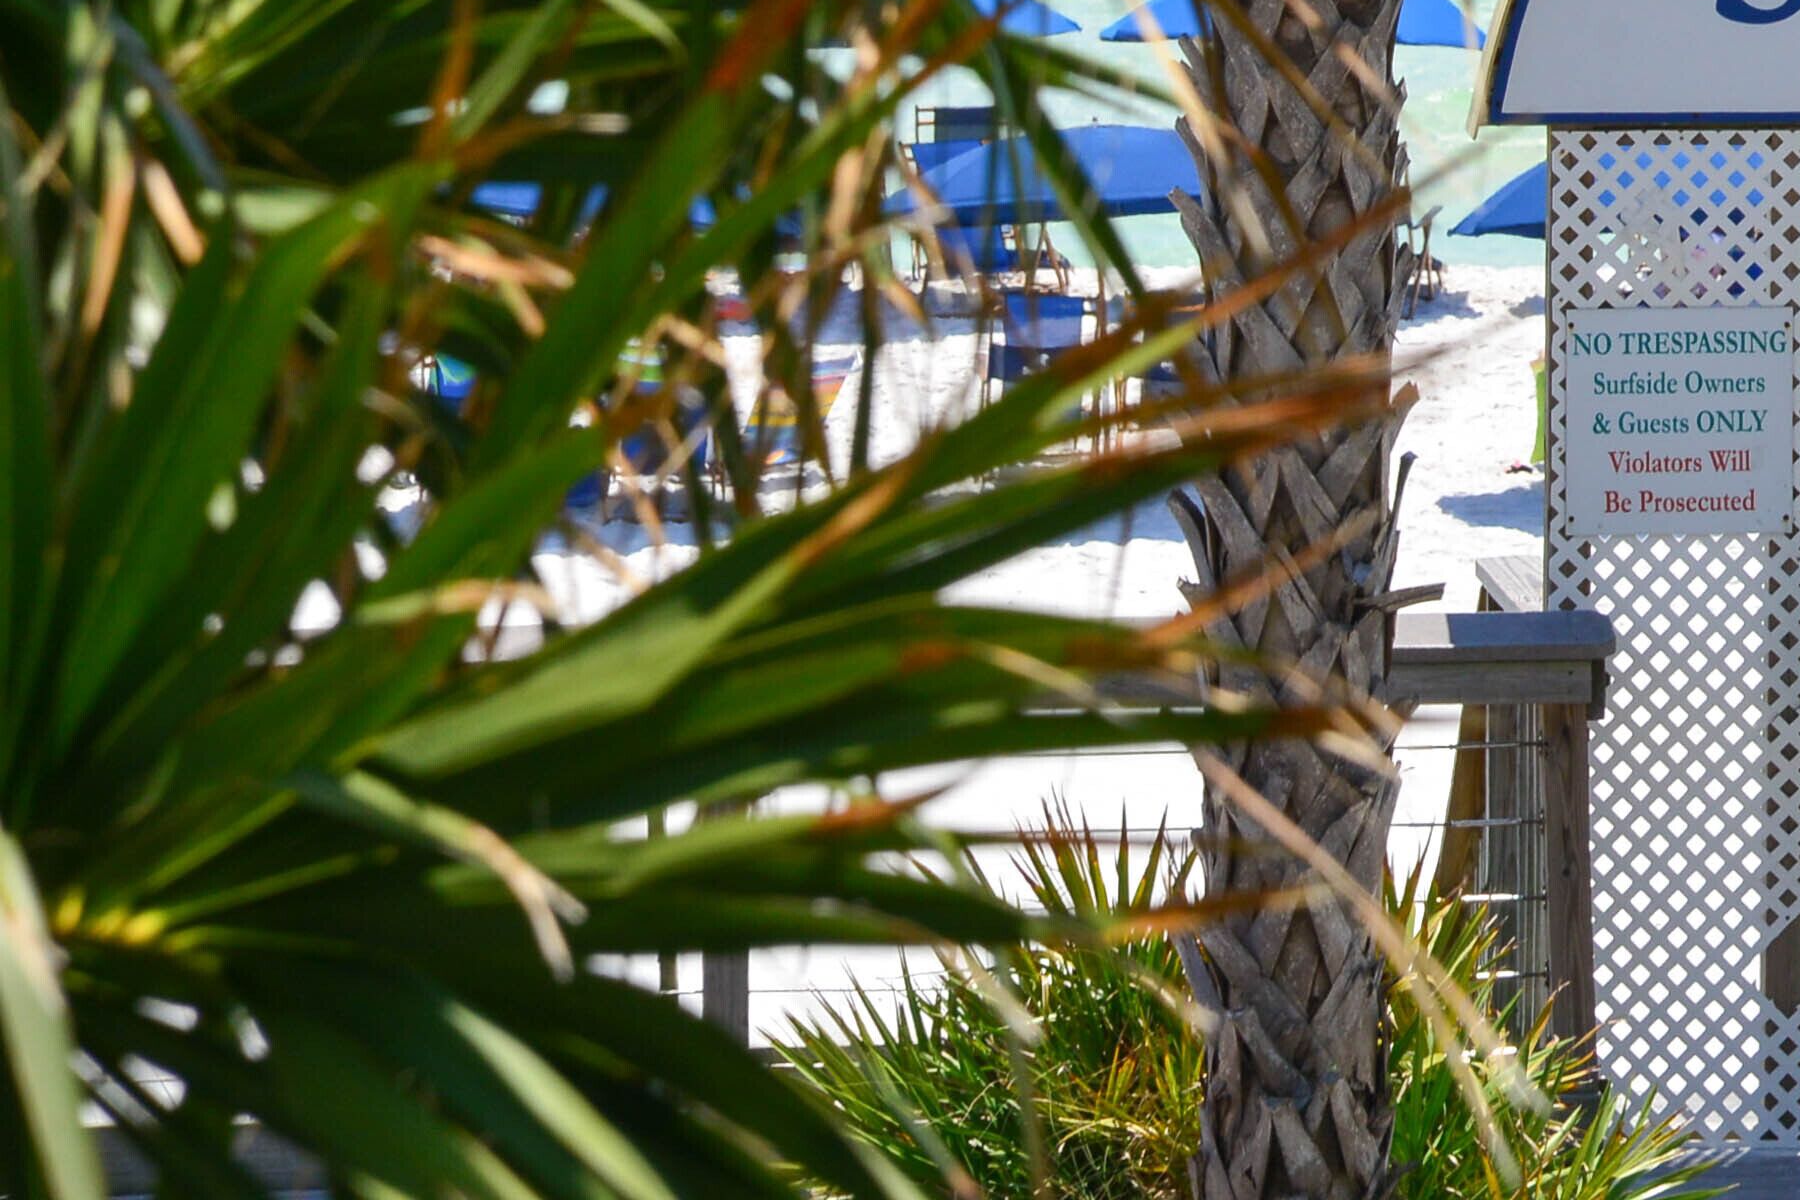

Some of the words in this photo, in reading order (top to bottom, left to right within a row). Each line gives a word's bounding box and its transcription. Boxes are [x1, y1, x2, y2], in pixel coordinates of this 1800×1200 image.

[1573, 332, 1611, 355] NO
[1619, 331, 1787, 354] TRESPASSING
[1593, 371, 1677, 395] Surfside
[1685, 370, 1766, 393] Owners
[1592, 412, 1611, 434] &
[1618, 411, 1690, 434] Guests
[1696, 409, 1767, 432] ONLY
[1608, 450, 1702, 474] Violators
[1709, 449, 1750, 472] Will
[1604, 490, 1632, 514] Be
[1639, 488, 1756, 513] Prosecuted
